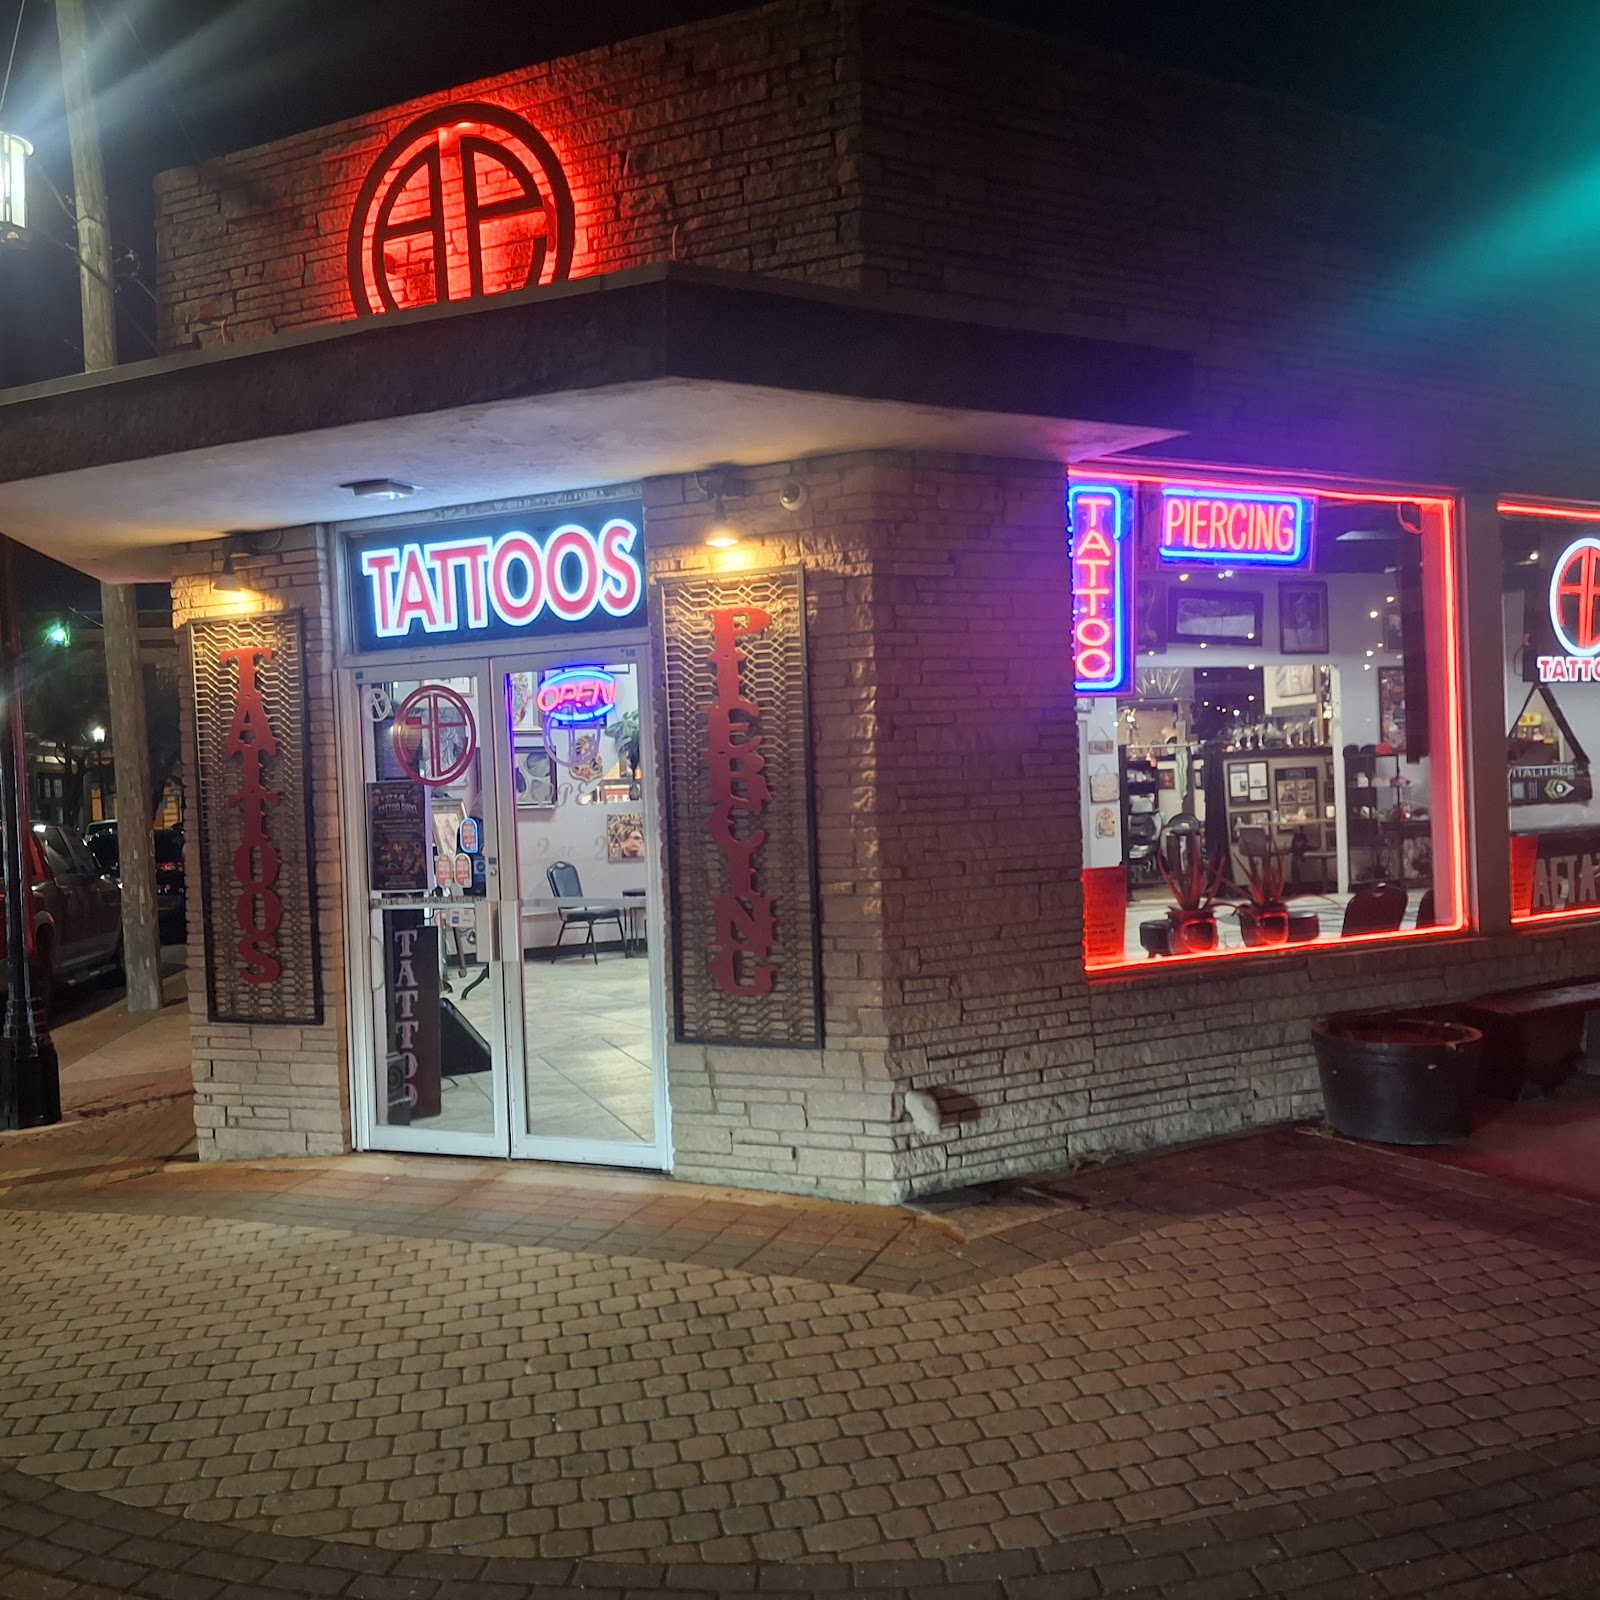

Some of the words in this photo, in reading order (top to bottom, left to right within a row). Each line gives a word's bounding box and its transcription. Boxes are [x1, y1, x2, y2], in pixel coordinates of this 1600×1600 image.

[361, 518, 642, 638] TATTOOS
[1165, 498, 1296, 553] PIERCING
[1075, 497, 1112, 679] TATTOO
[537, 680, 617, 712] OPEN
[219, 646, 283, 986] TATTOOS
[705, 607, 783, 997] PIERCING
[1533, 853, 1600, 908] AFTA
